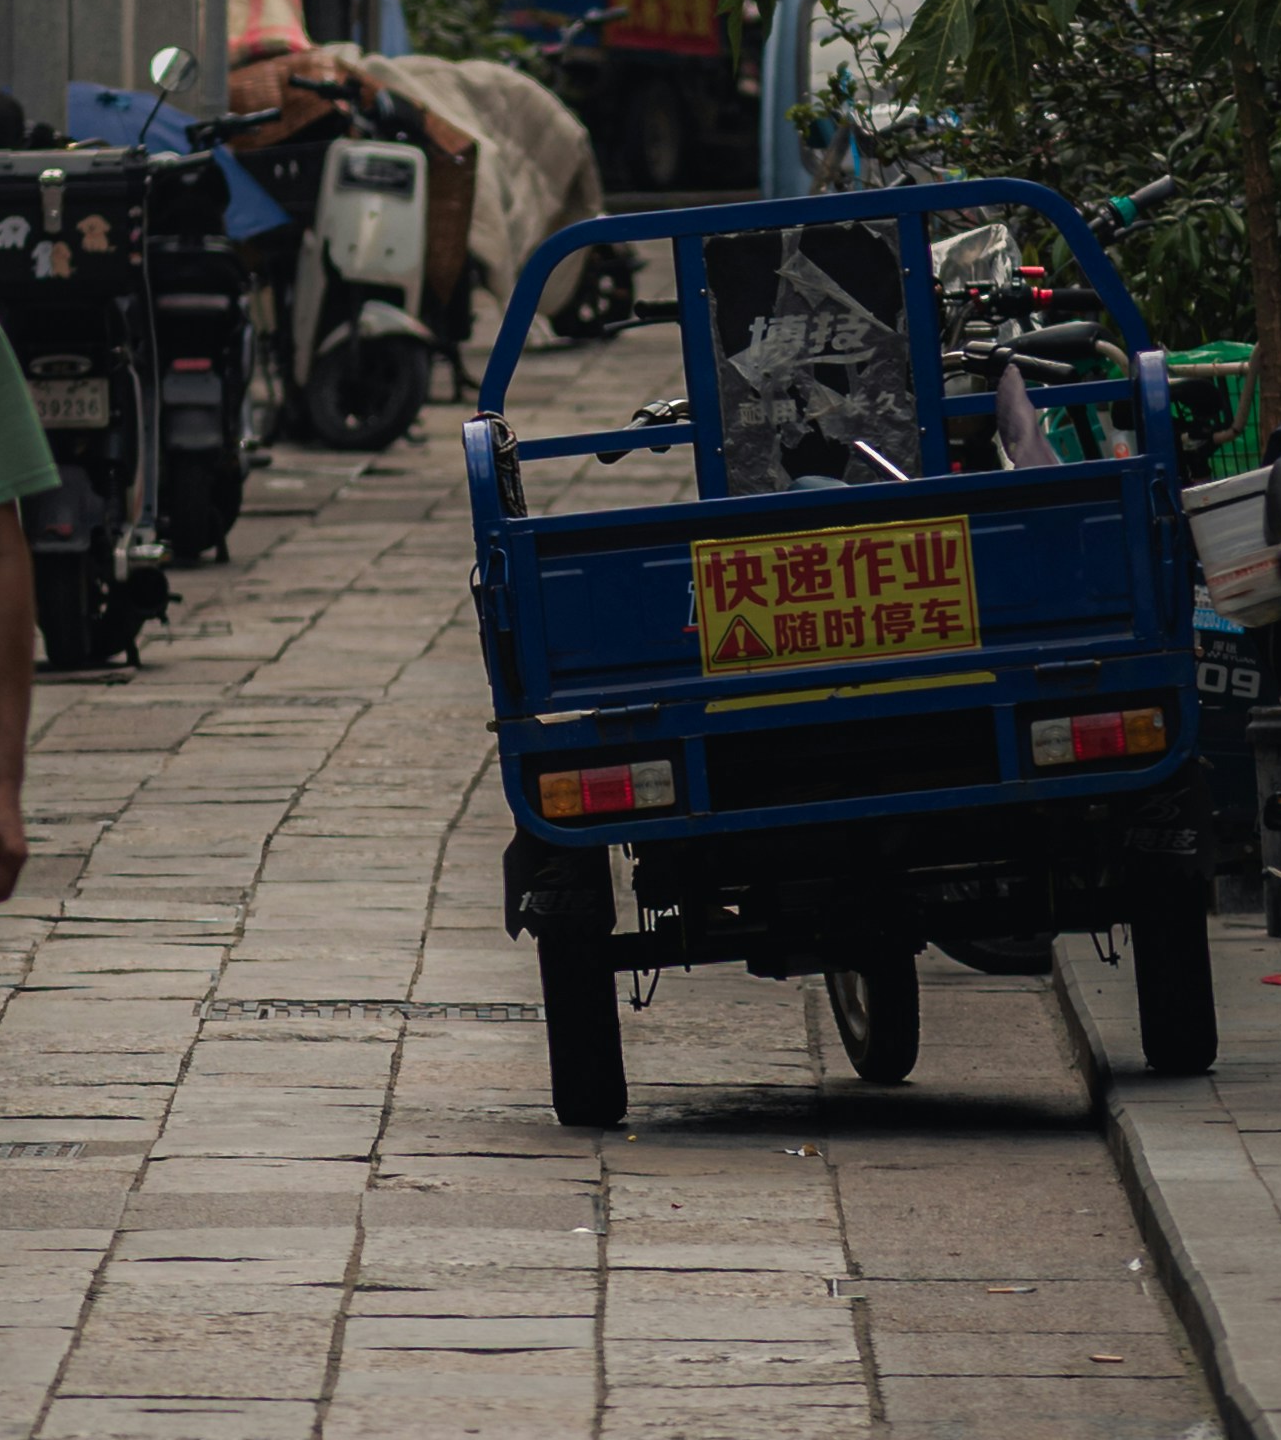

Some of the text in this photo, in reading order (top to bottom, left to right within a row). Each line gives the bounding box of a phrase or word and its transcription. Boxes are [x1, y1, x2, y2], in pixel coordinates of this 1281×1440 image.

[704, 530, 961, 613] 快递作业
[773, 597, 965, 657] 随时停车
